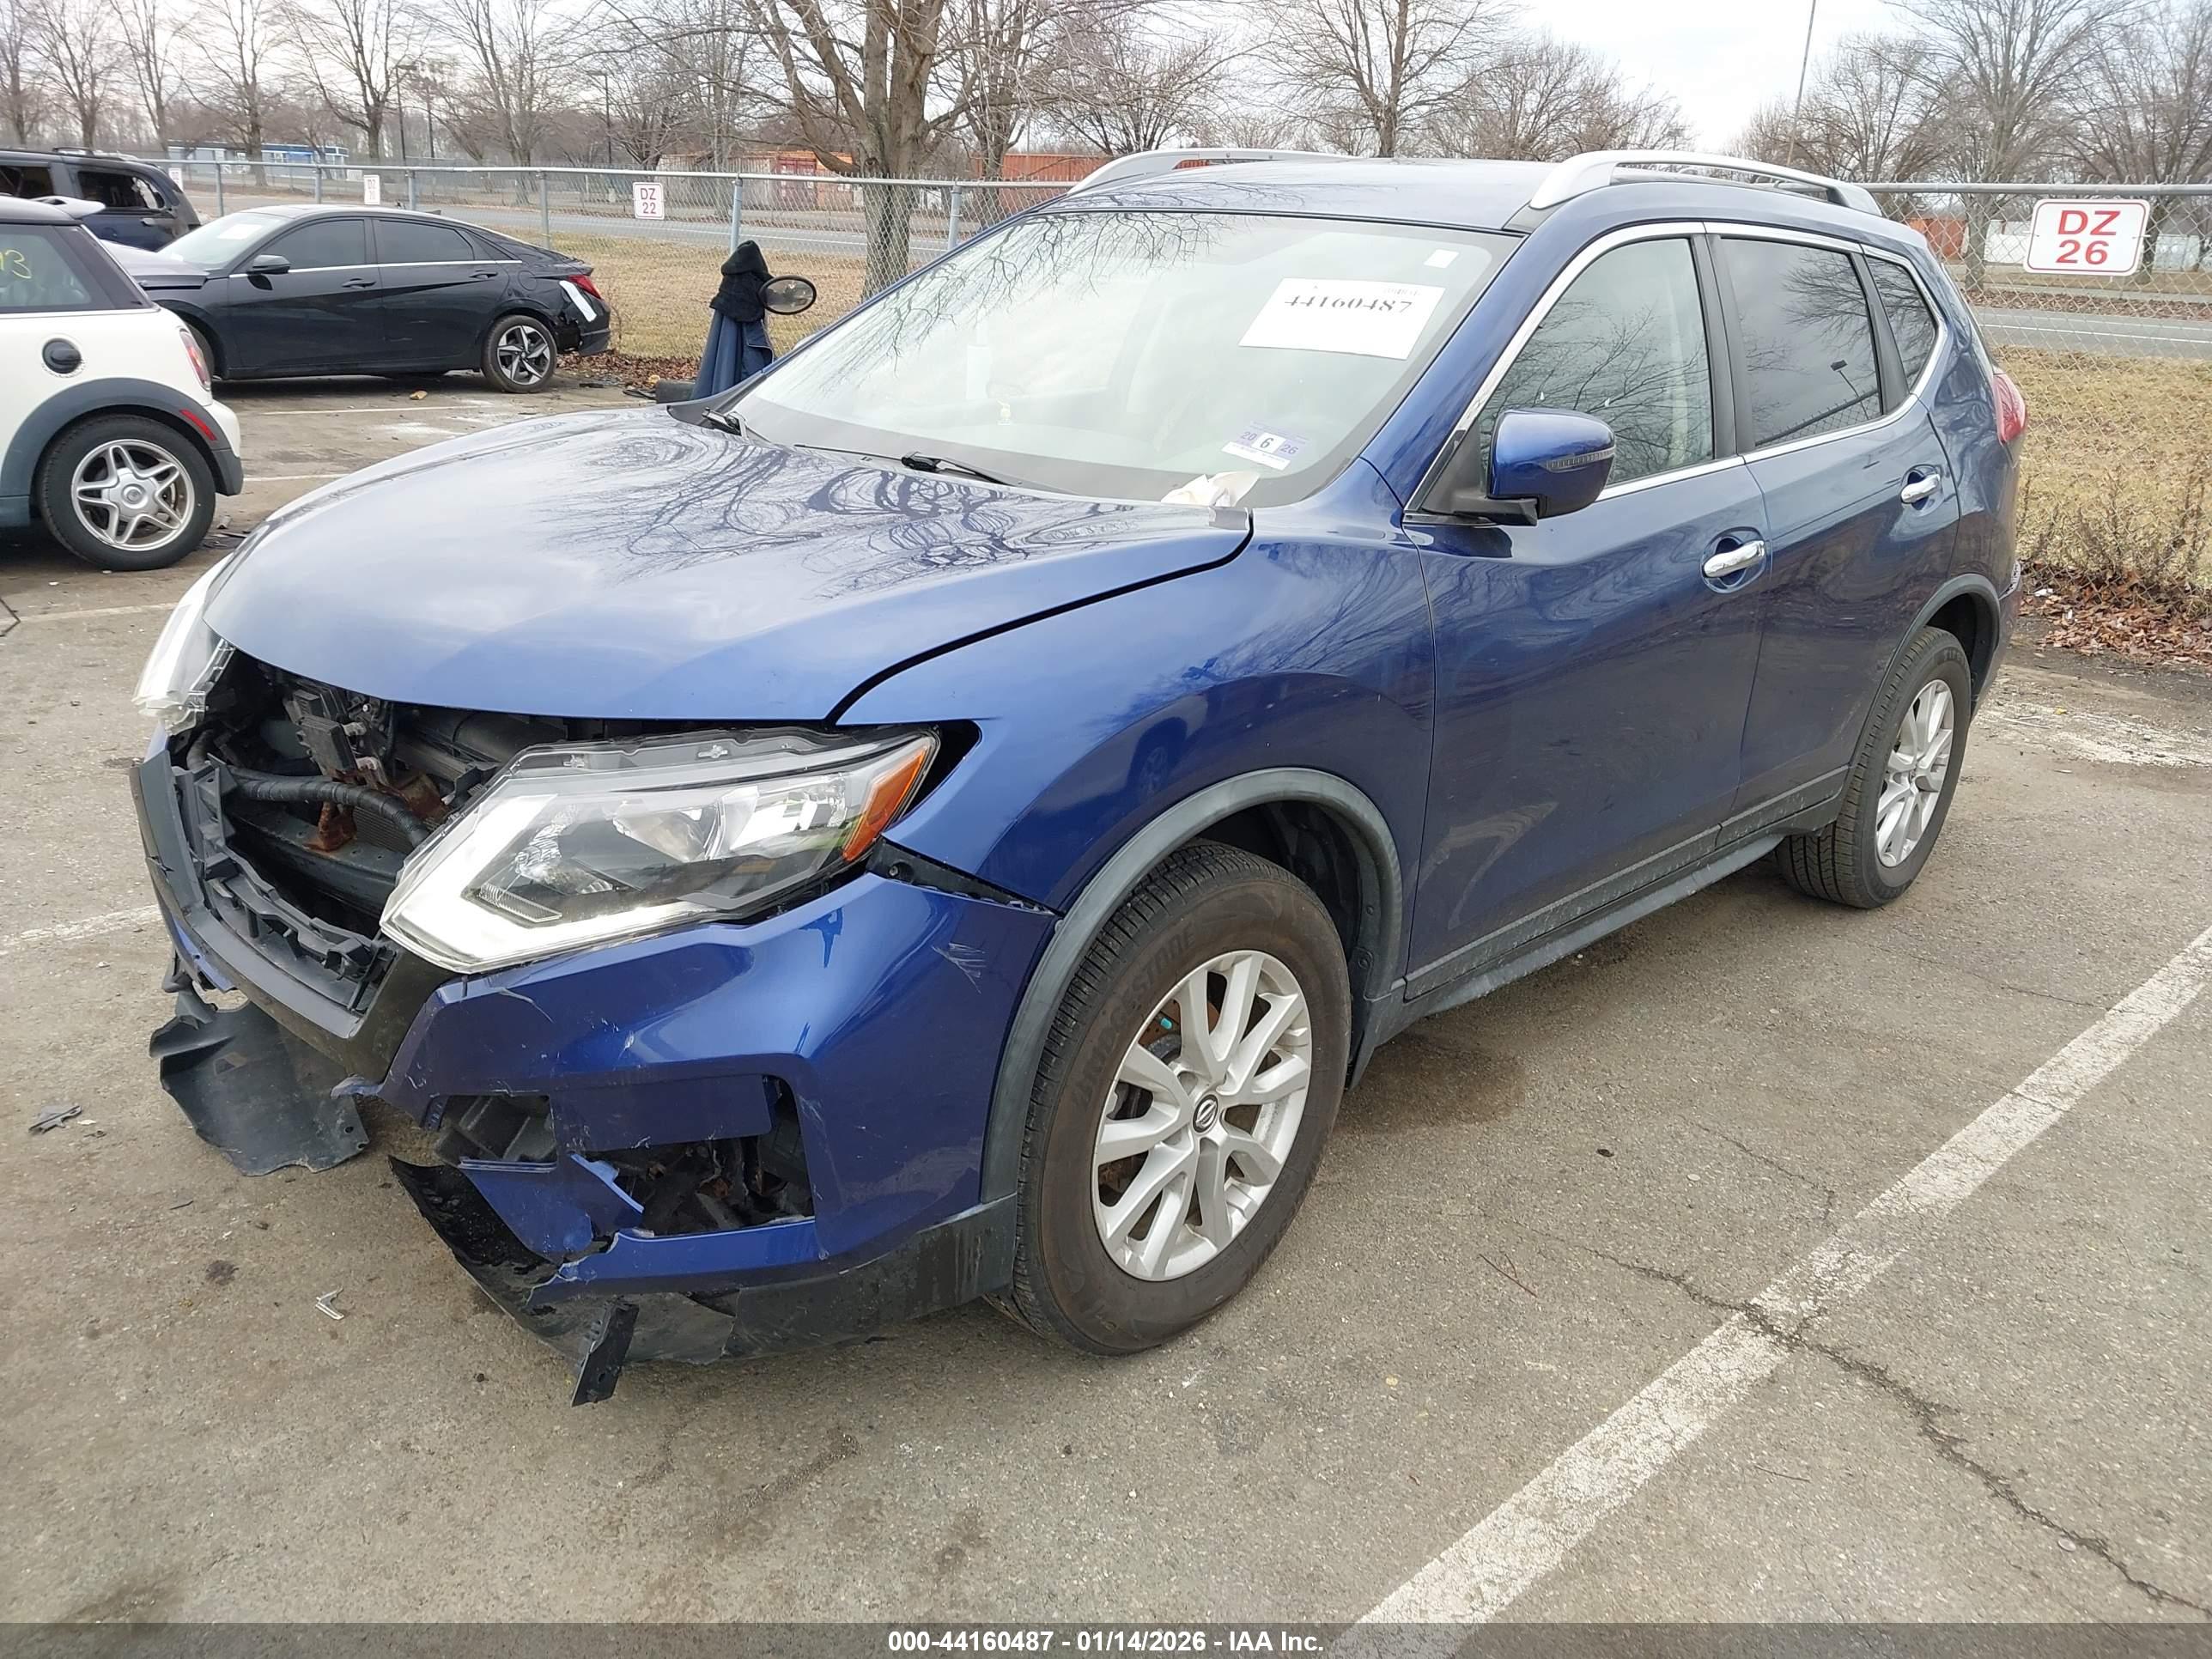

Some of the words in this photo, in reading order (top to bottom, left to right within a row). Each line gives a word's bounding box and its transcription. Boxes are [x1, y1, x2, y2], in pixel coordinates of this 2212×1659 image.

[640, 187, 657, 200] DZ
[642, 202, 657, 214] 22
[2057, 210, 2121, 236] DZ
[2056, 239, 2110, 264] 26
[1284, 295, 1413, 313] 44160487
[1240, 430, 1258, 441] 20
[1260, 437, 1274, 449] 6
[1280, 443, 1299, 455] 26
